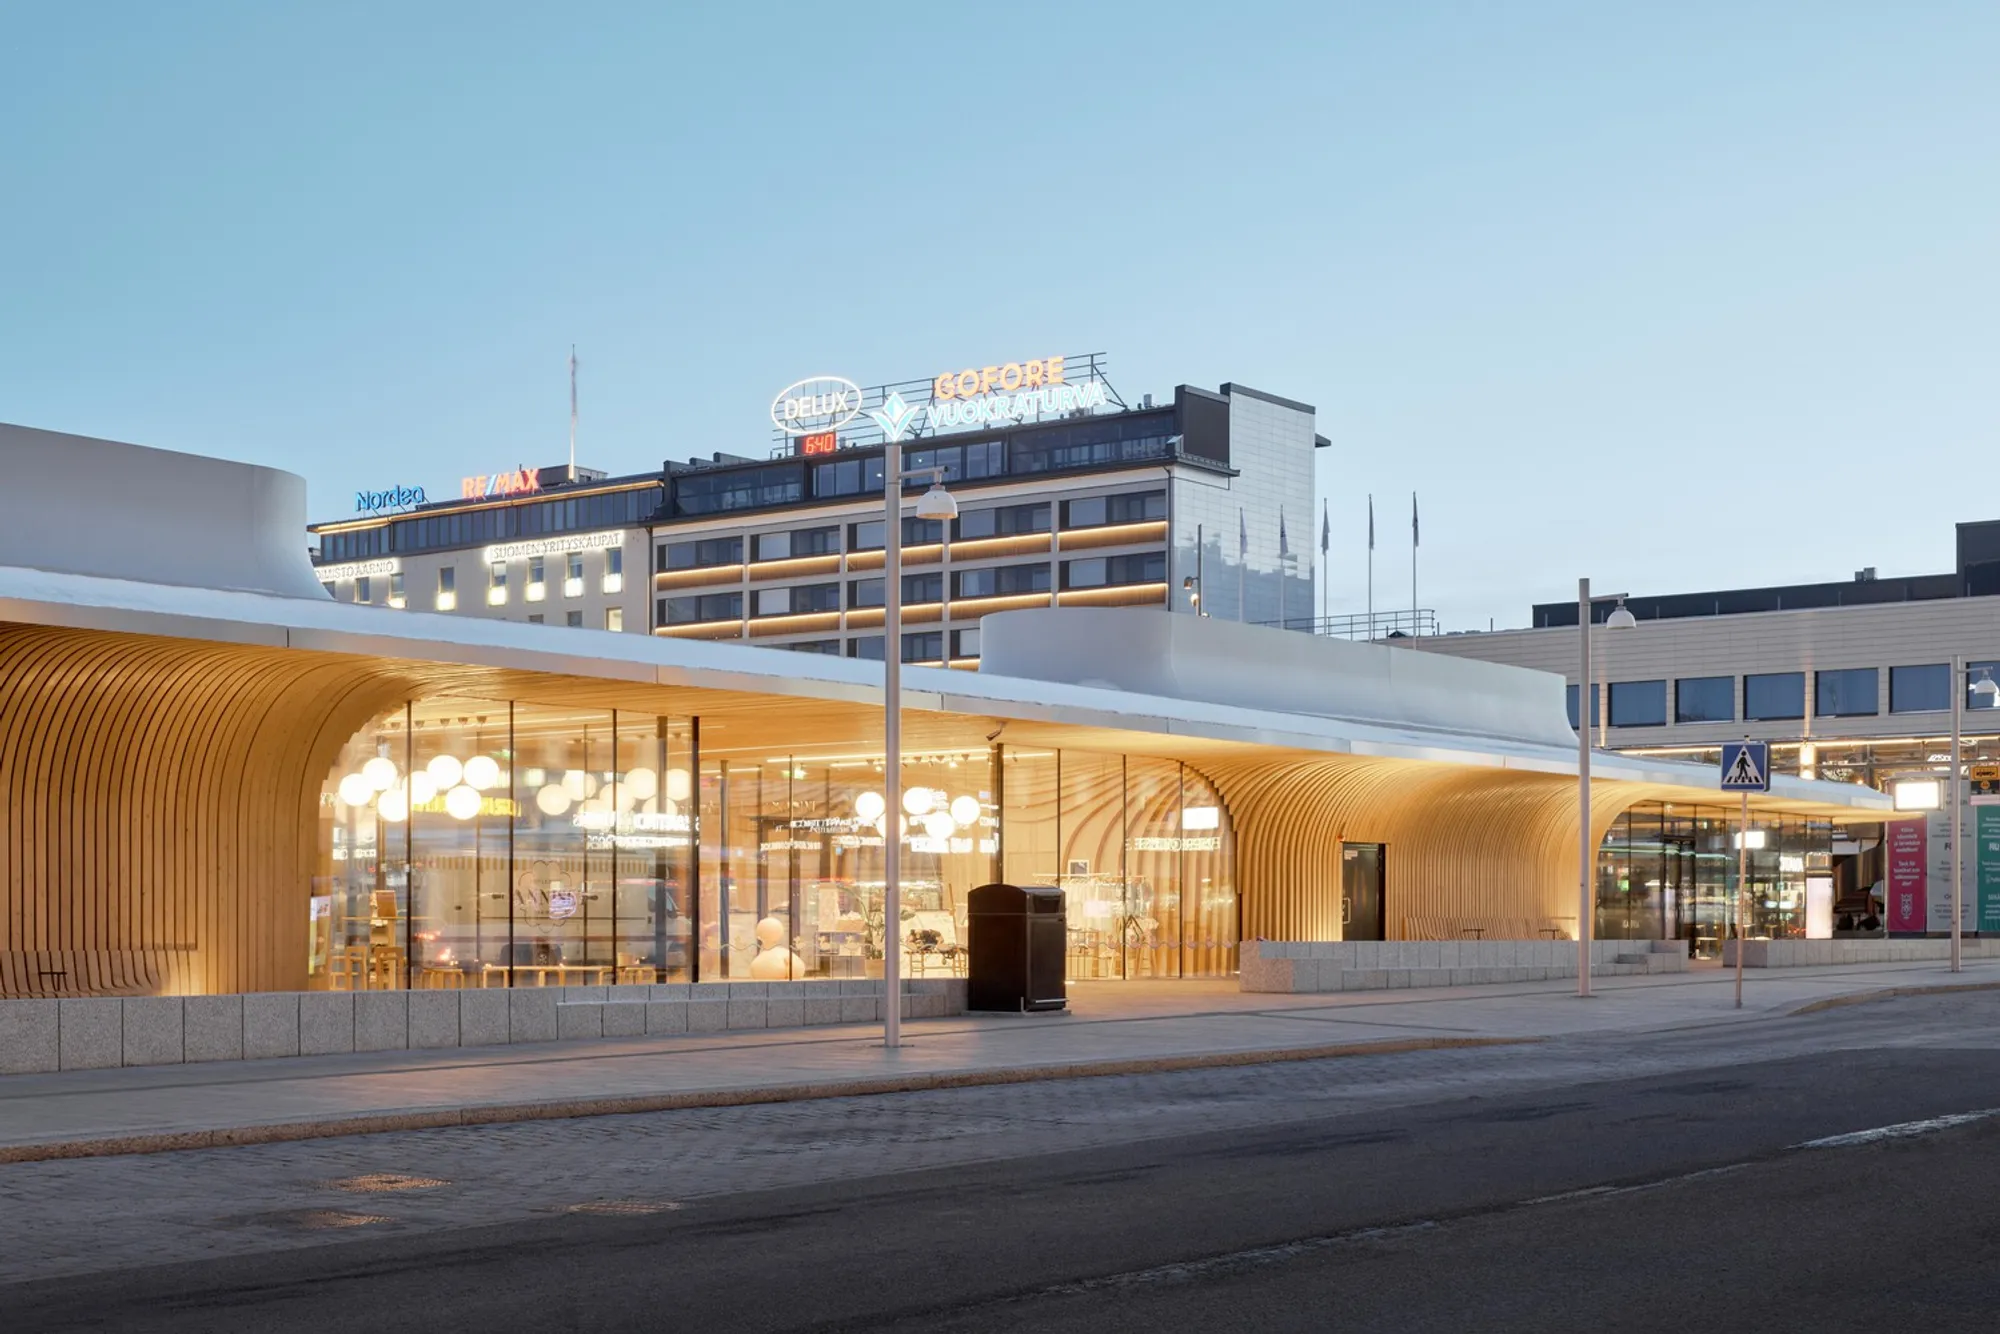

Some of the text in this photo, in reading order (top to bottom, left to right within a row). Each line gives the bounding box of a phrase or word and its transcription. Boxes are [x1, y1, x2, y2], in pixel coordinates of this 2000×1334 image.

[934, 355, 1065, 400] GOFORE
[783, 390, 849, 420] DELUX
[926, 381, 1107, 429] VUOKRATURVA
[356, 484, 426, 512] Nordea
[461, 468, 540, 499] RE/MAX
[492, 531, 622, 560] SUOMEN YRITYSKAUPAT
[355, 560, 395, 577] AARNIO
